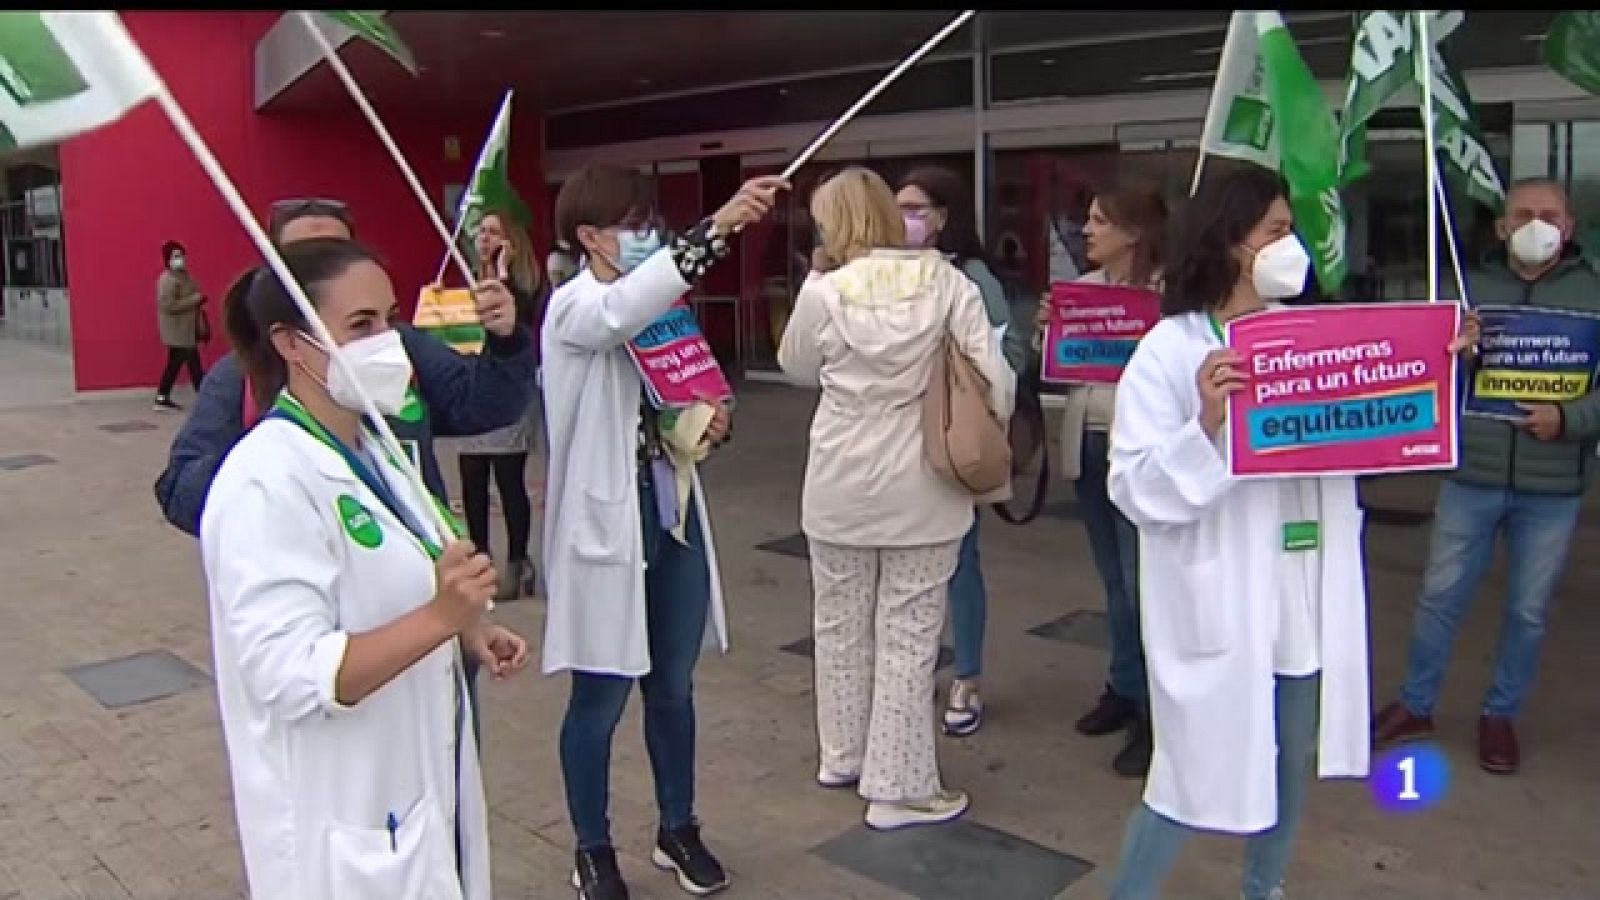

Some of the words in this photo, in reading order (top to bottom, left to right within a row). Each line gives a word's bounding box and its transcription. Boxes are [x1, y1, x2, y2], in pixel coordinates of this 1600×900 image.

[1253, 339, 1393, 375] Enfermeras
[1516, 352, 1538, 364] un
[1541, 349, 1589, 364] futuro
[1256, 377, 1311, 403] para
[1316, 373, 1349, 391] un
[1352, 359, 1426, 384] futuro
[1482, 374, 1584, 393] innovador
[1261, 398, 1419, 441] equitativo
